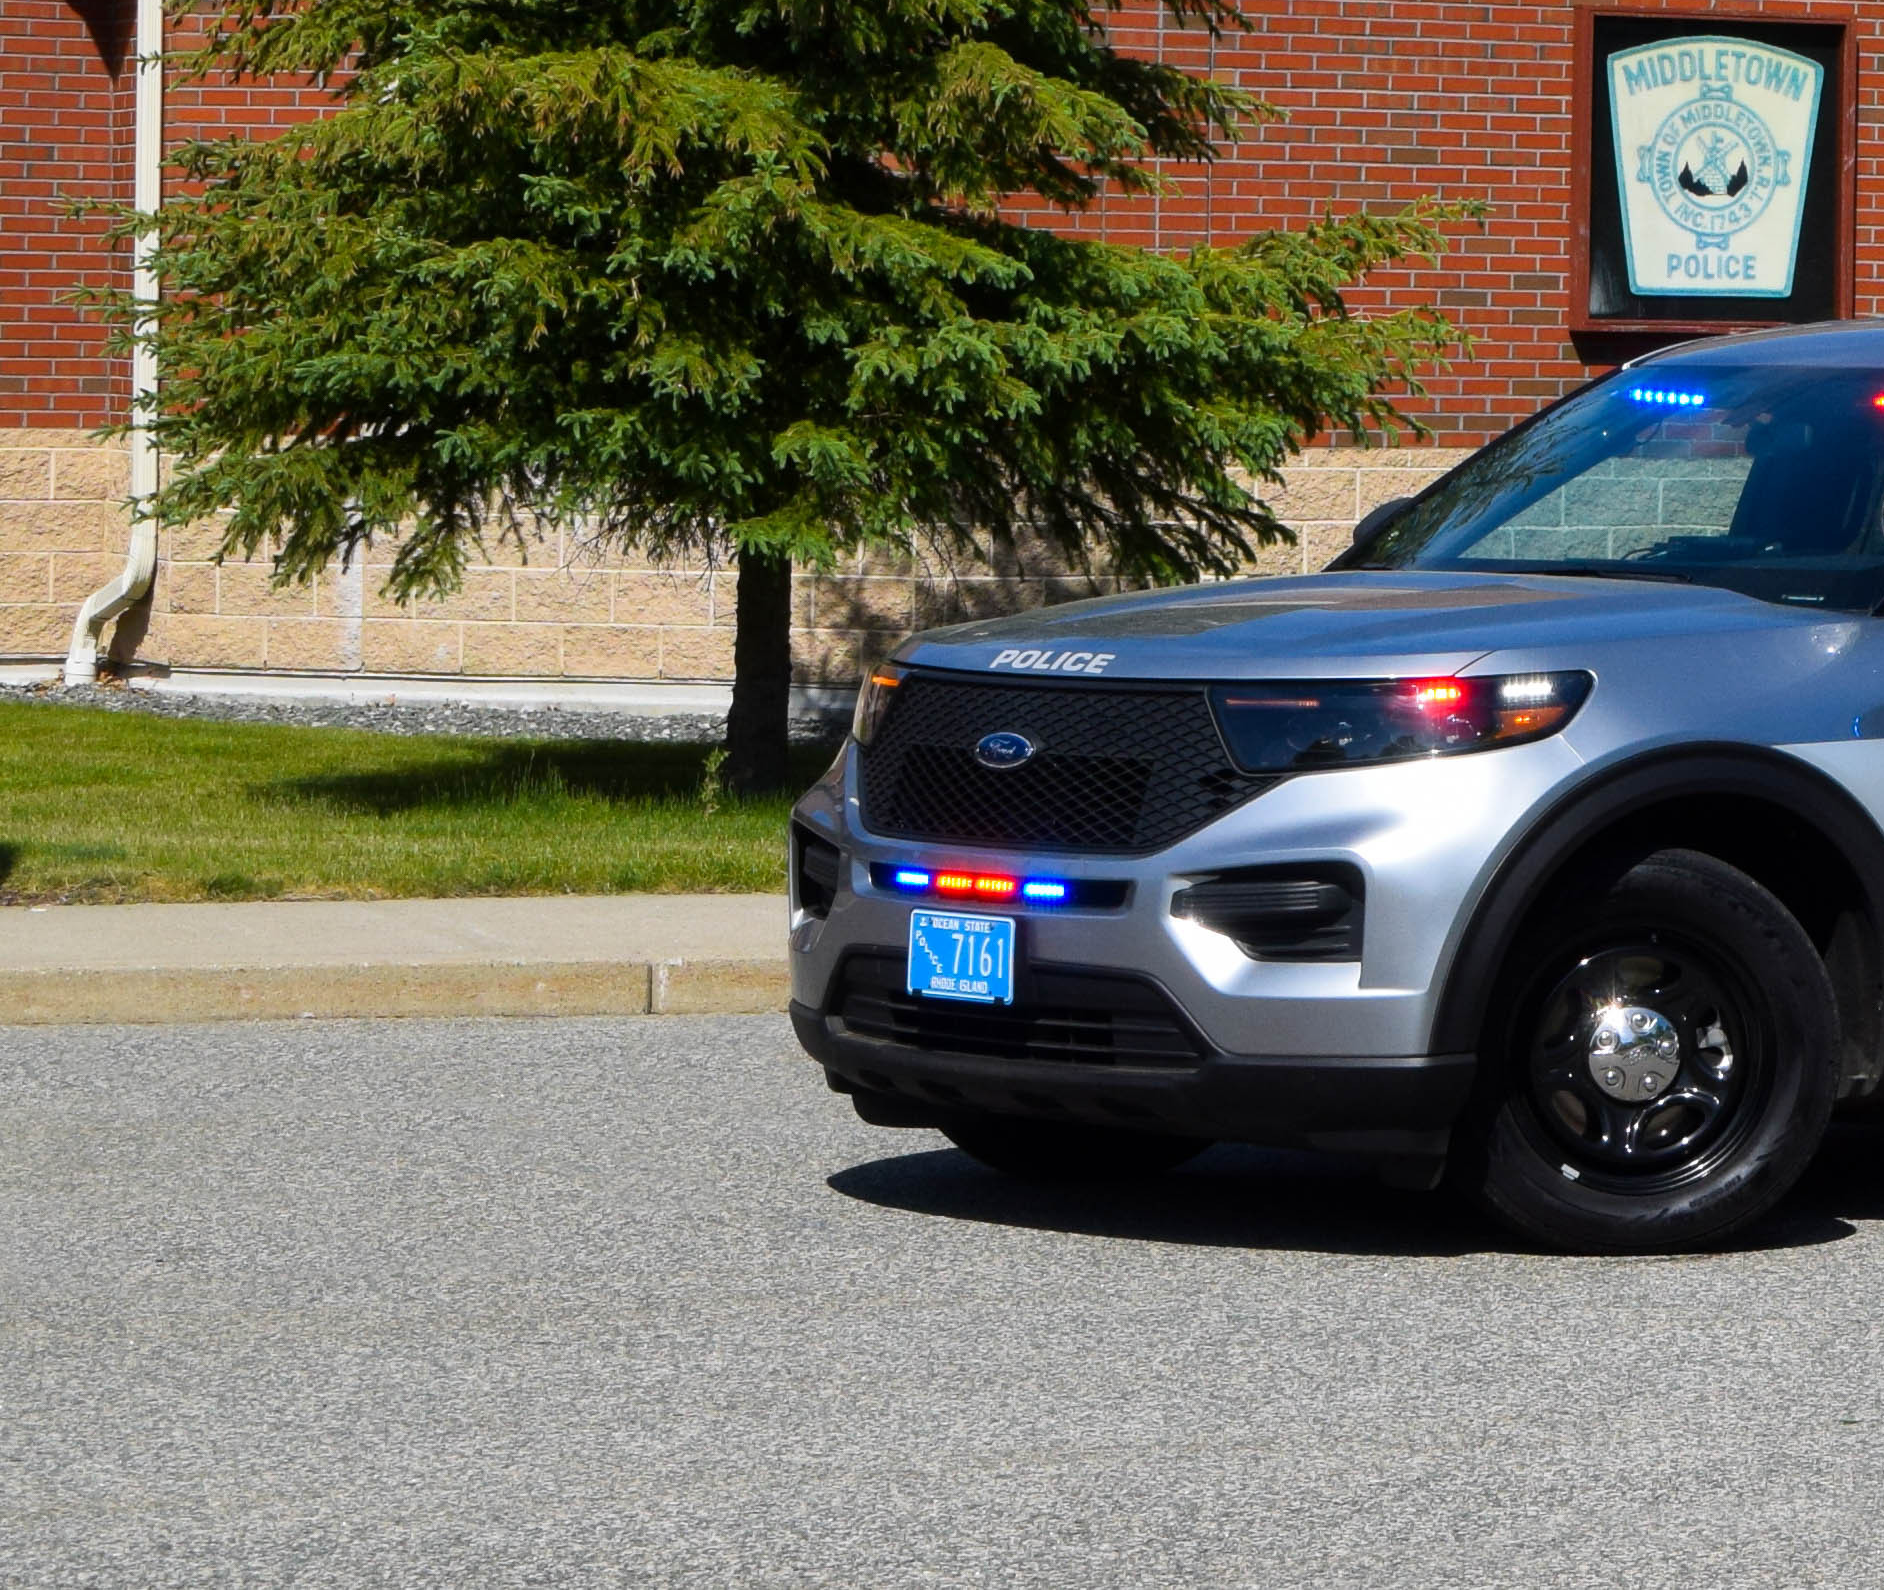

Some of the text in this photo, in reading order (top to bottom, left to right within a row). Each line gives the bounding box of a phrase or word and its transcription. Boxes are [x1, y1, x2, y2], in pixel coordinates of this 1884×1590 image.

[1622, 49, 1809, 101] MIDDLETOWN
[1663, 122, 1680, 145] OF
[1656, 150, 1676, 204] TOWN
[1666, 253, 1756, 280] POLICE
[989, 649, 1116, 674] POLICE
[916, 929, 943, 974] POLICE
[952, 932, 1004, 979] 7161
[930, 976, 988, 994] RHODE ISLAND
